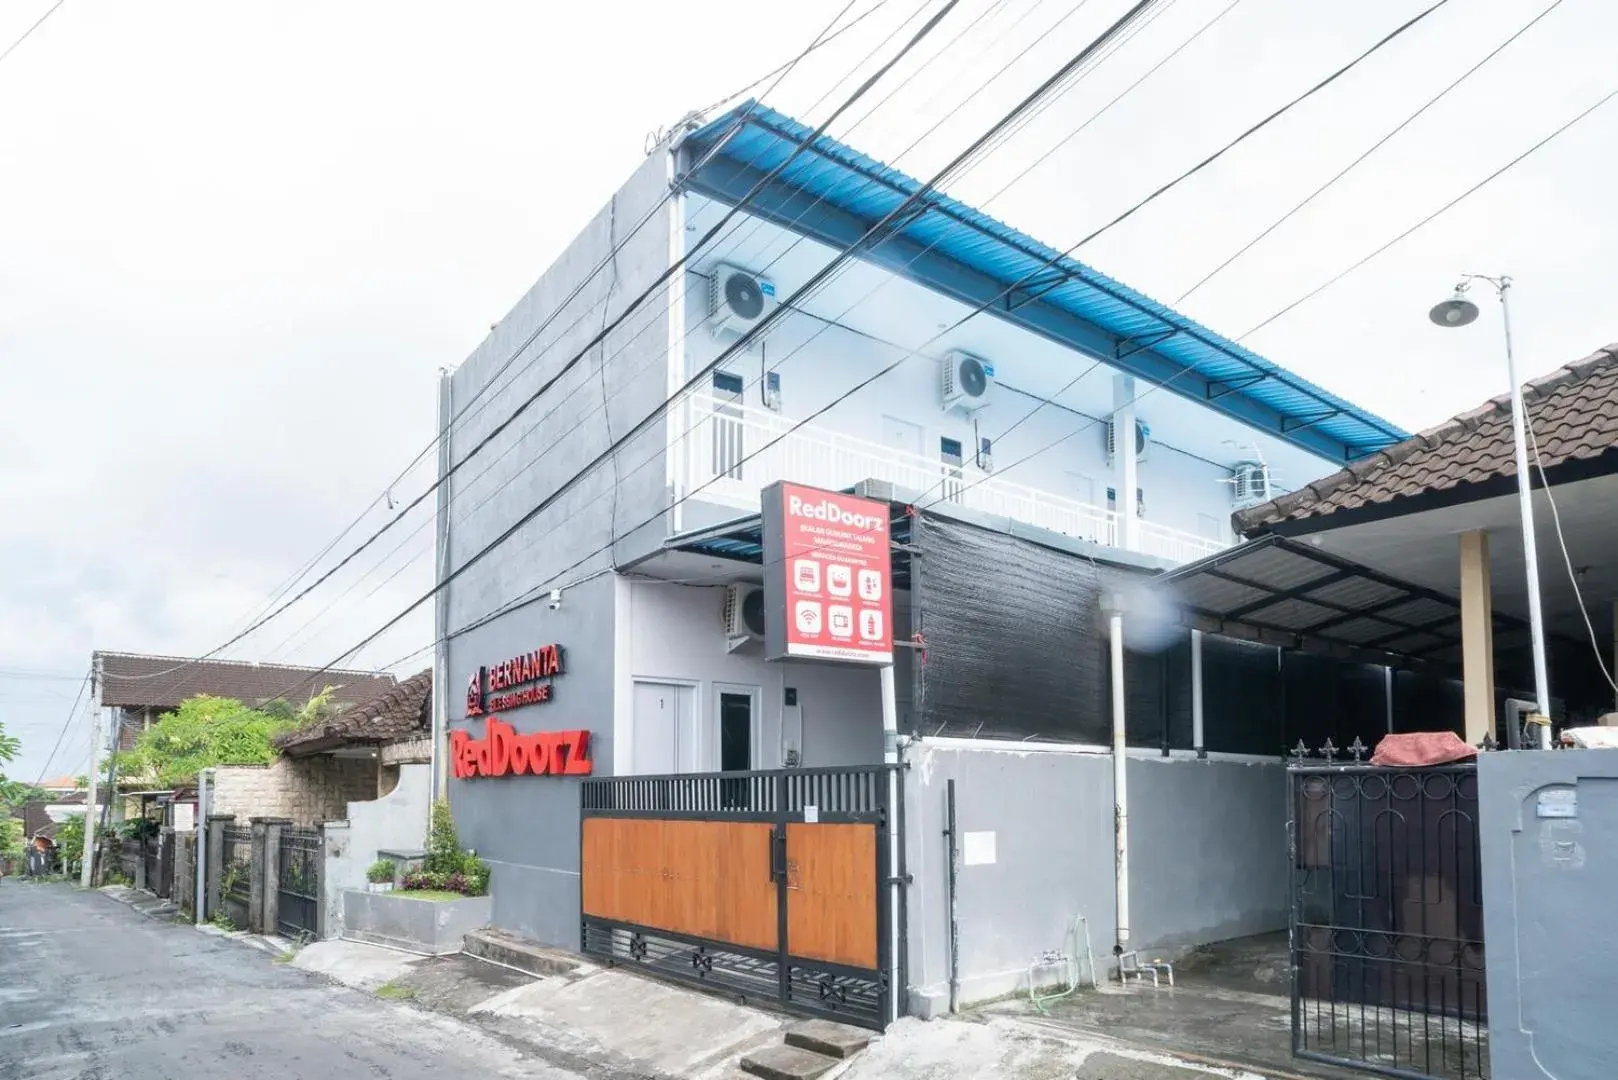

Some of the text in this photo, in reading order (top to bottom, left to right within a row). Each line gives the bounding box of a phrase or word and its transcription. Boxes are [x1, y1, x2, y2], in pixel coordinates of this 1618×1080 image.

[789, 495, 884, 531] RedDoorz
[488, 644, 561, 692] BERNANTA
[489, 684, 550, 713] BLESSING HOUSE
[450, 717, 592, 779] RedDoorz
